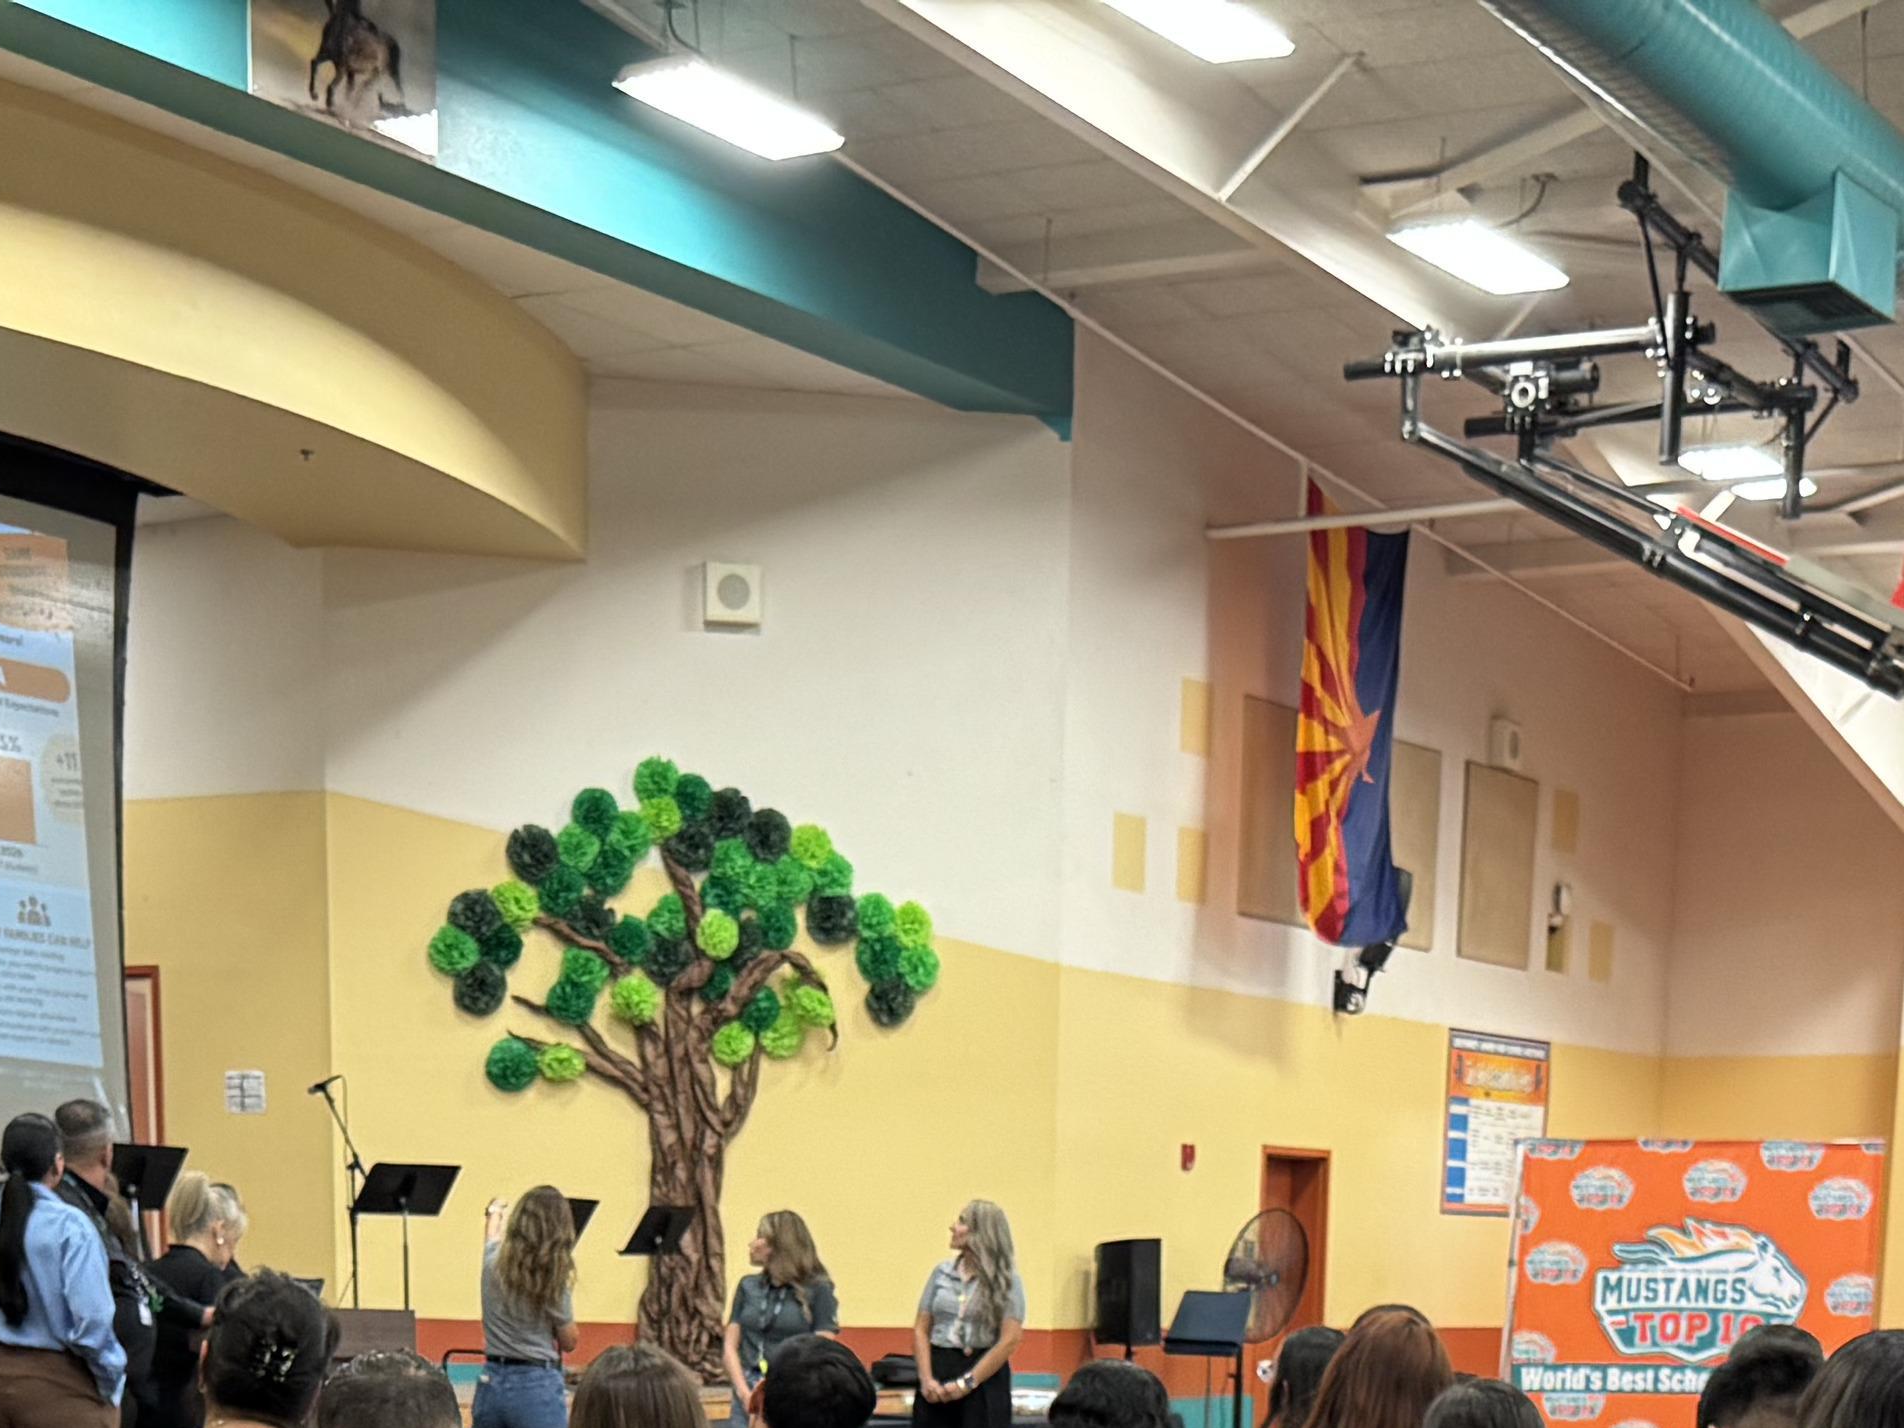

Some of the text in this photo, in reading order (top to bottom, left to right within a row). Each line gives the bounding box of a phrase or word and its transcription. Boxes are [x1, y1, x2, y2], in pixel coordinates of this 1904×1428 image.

[1601, 1275, 1746, 1305] MUSTANGS
[1633, 1312, 1710, 1344] TOP
[1521, 1366, 1603, 1391] World's
[1607, 1367, 1655, 1391] Best
